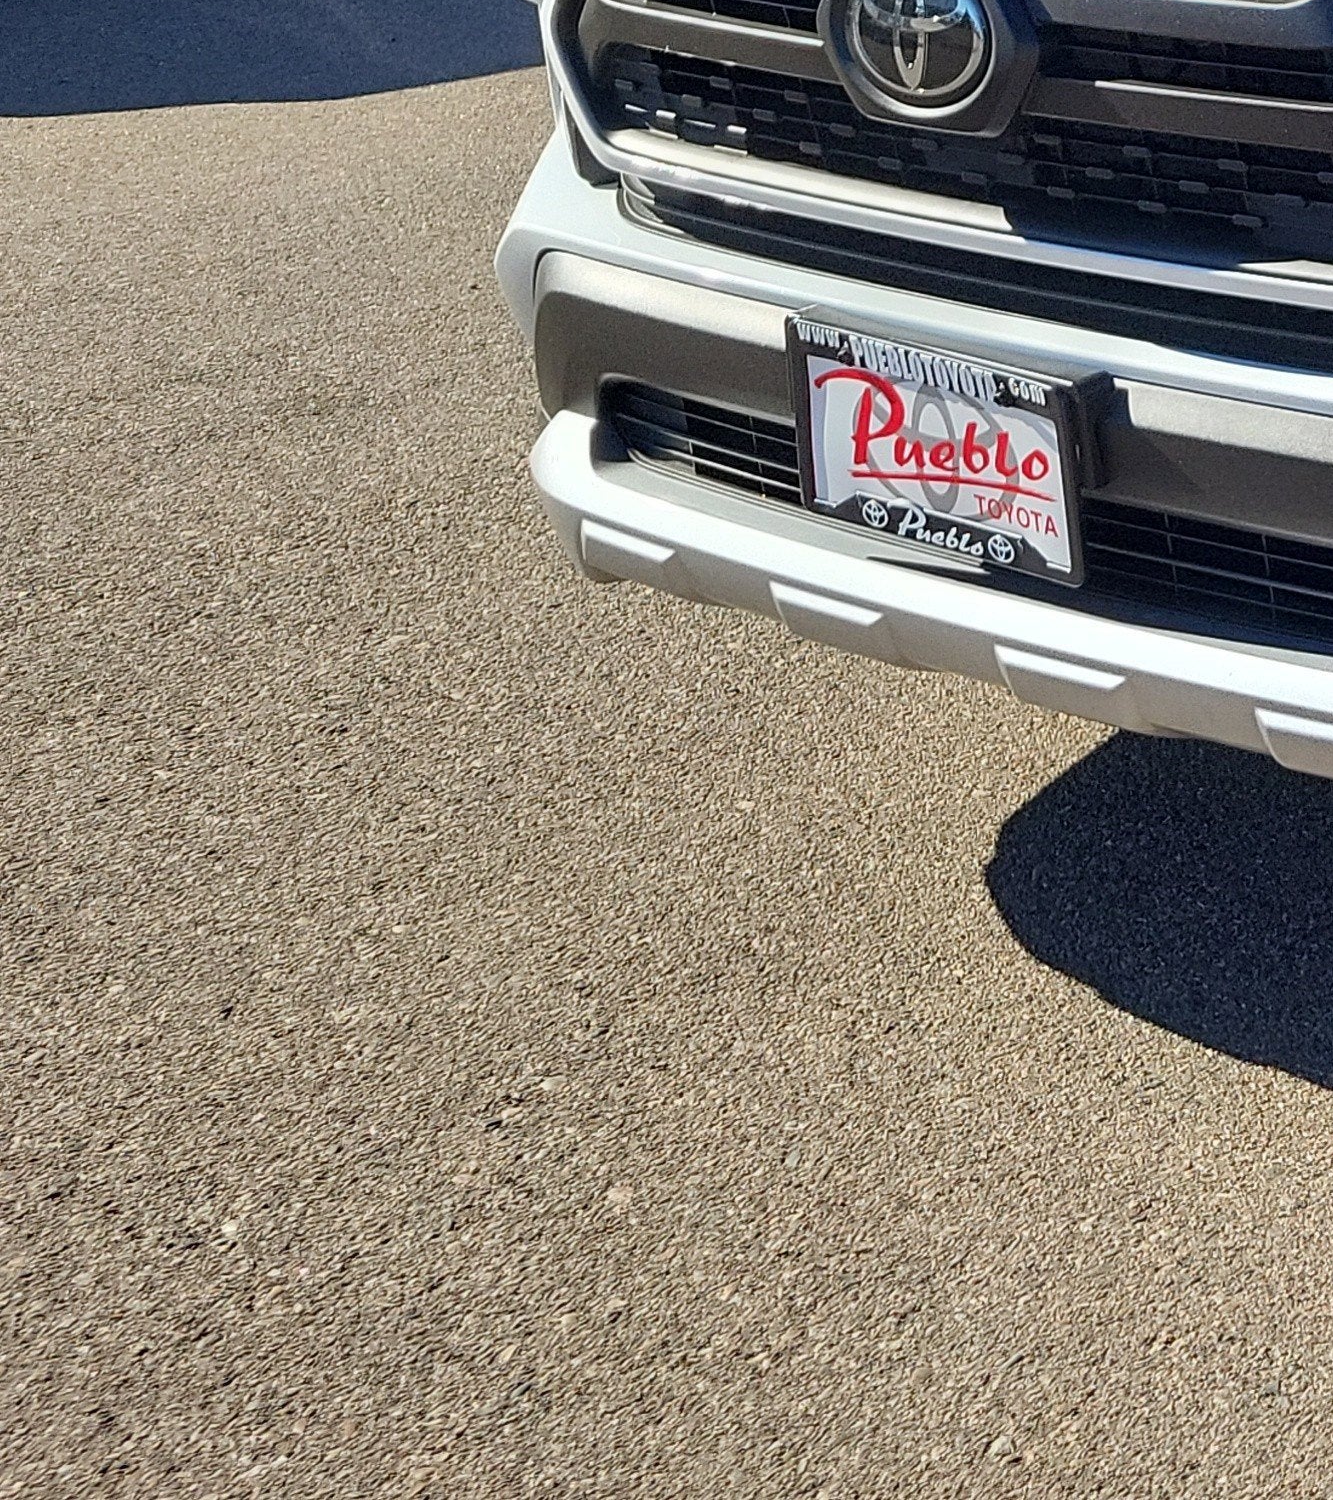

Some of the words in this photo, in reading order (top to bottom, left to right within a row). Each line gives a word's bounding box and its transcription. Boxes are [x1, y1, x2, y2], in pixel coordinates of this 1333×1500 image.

[814, 367, 1050, 482] Pueblo
[887, 498, 984, 556] Pueblo
[973, 494, 1059, 538] TOYOTA
